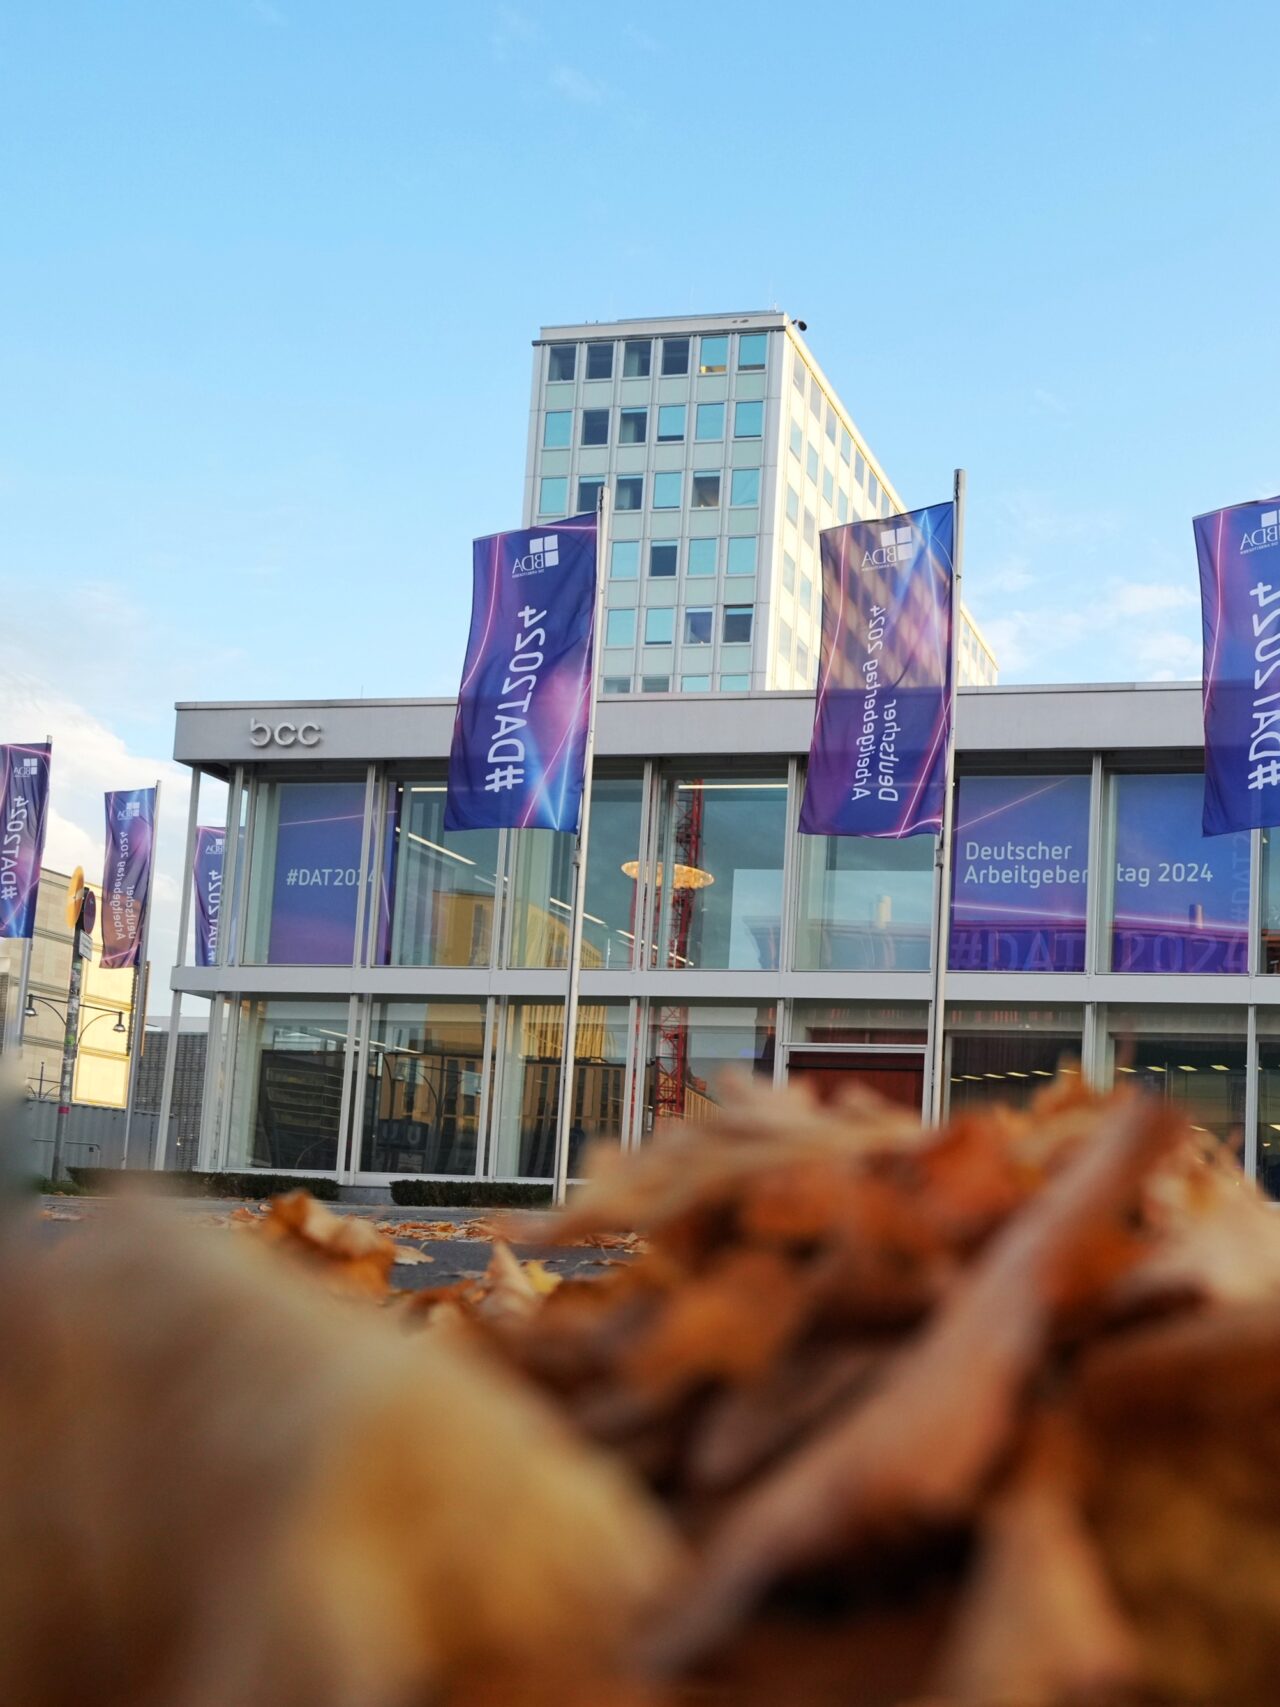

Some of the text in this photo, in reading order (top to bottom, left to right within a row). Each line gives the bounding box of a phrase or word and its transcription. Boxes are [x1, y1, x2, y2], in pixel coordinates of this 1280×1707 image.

[250, 717, 321, 747] bcc
[965, 841, 1072, 860] Deutscher
[1157, 863, 1213, 882] 2024
